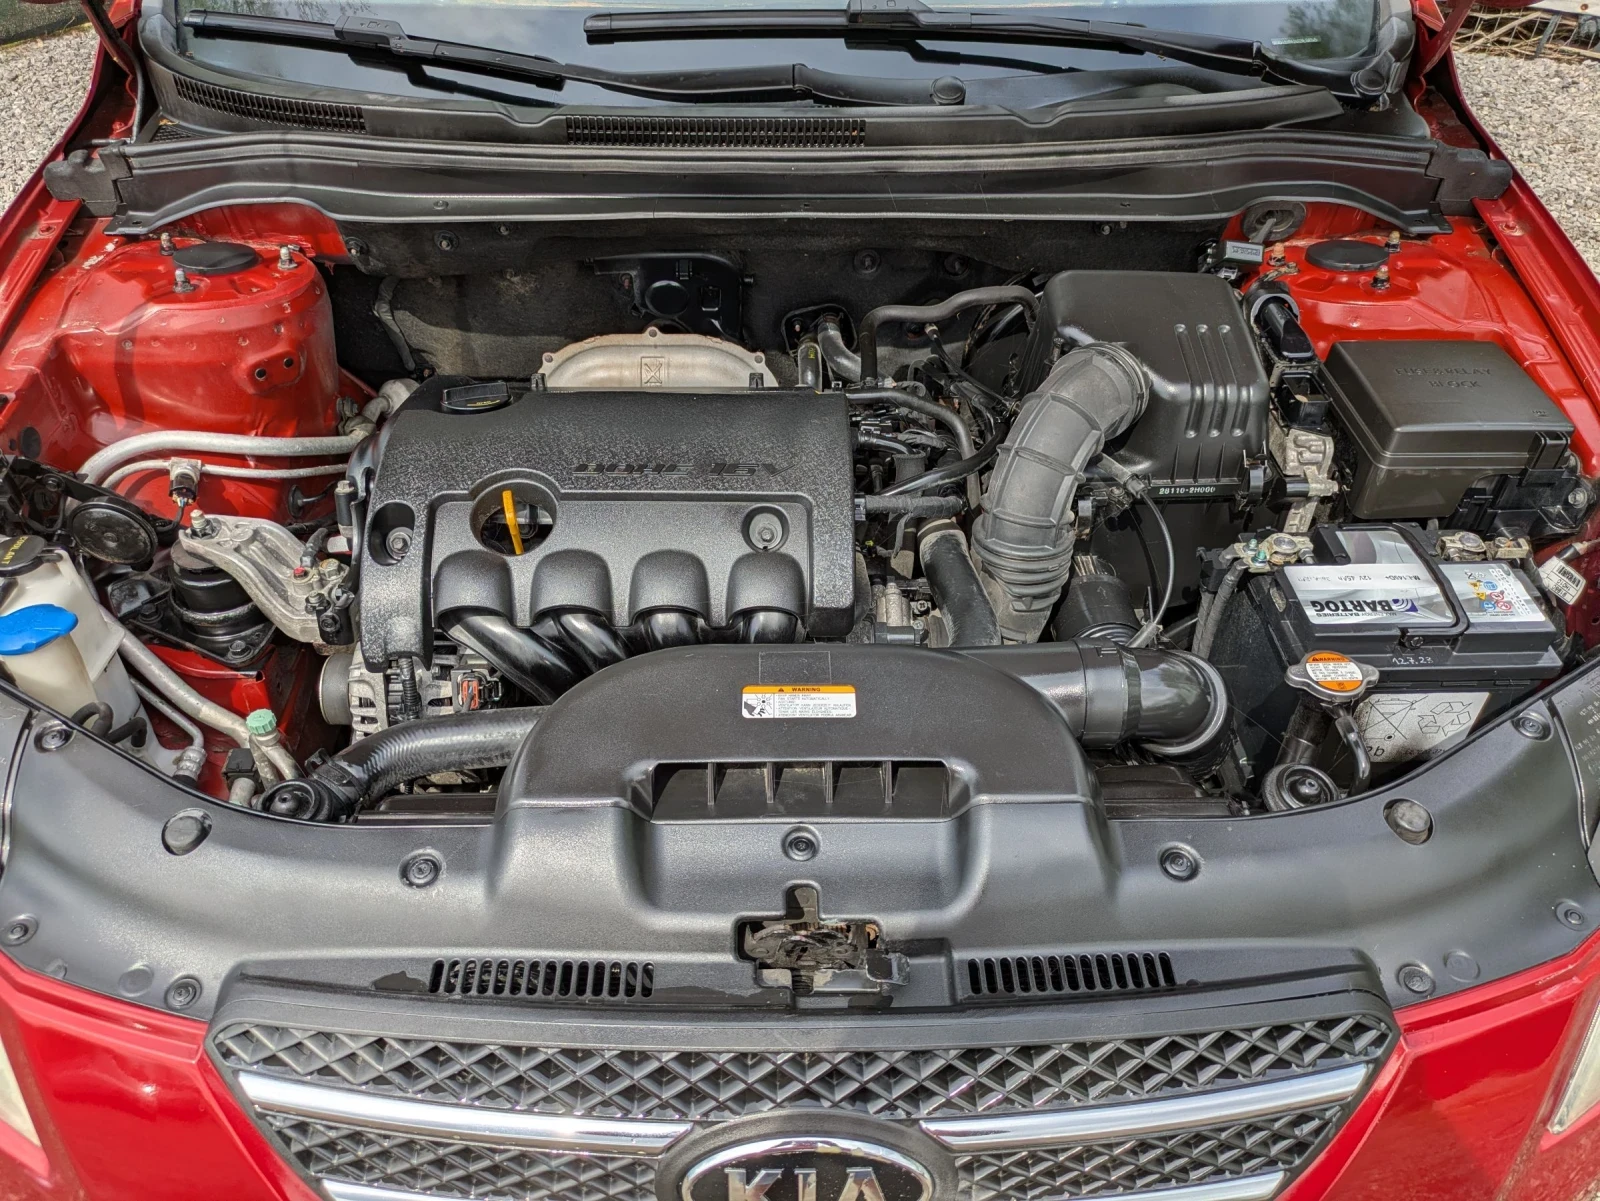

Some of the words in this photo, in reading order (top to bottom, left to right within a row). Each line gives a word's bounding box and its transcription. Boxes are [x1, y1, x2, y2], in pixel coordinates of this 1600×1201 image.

[1429, 380, 1482, 389] BLOCK
[572, 463, 695, 477] DOHC
[708, 462, 796, 478] 16V
[1, 536, 29, 565] COOLANT
[1310, 600, 1393, 612] BARTOG
[724, 1168, 886, 1201] KIA
